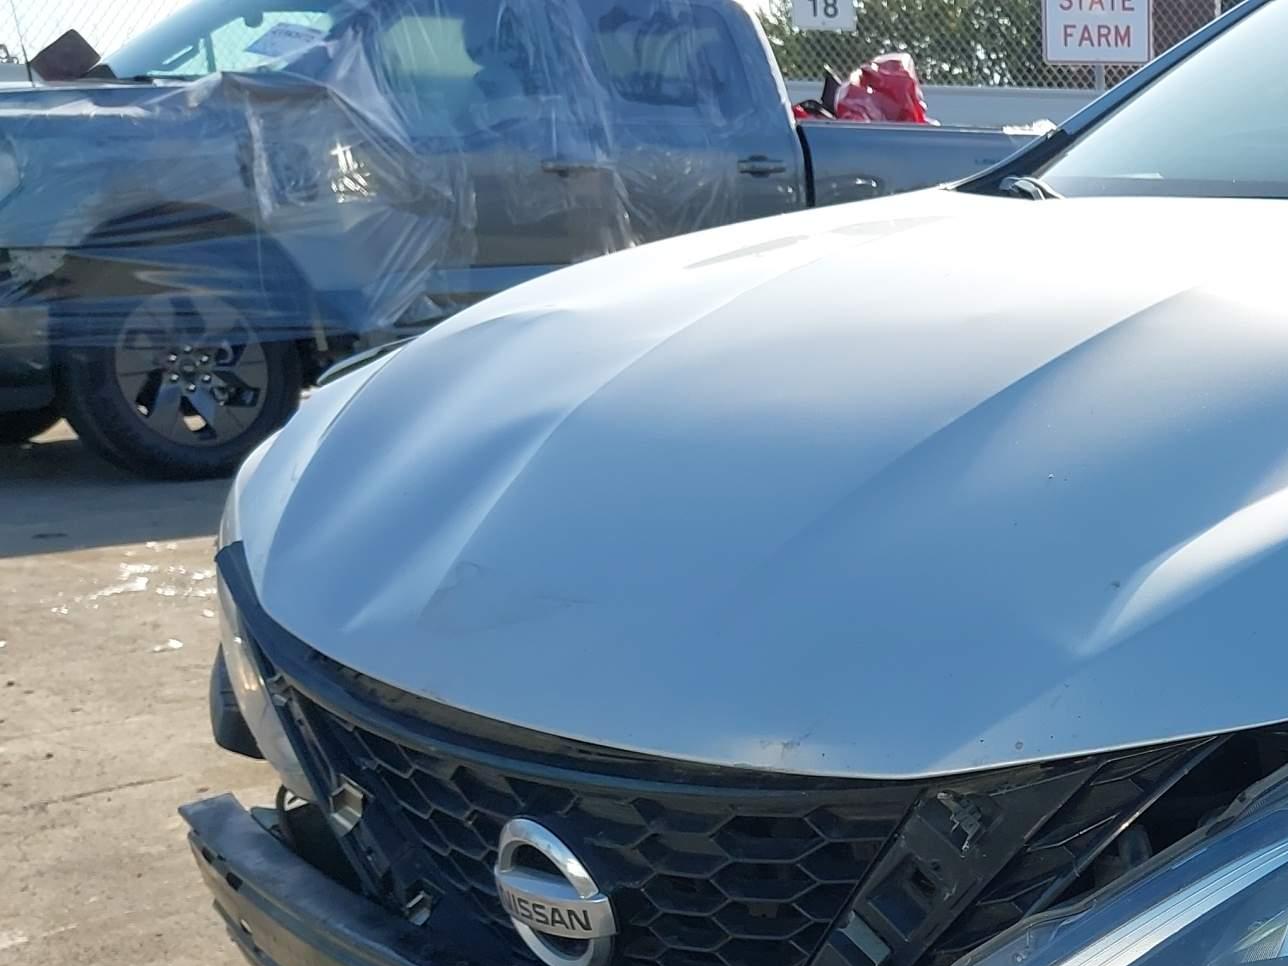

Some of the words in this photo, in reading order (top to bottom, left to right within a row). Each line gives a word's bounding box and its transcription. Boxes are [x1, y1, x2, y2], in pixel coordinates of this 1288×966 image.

[808, 0, 838, 18] 18
[1063, 24, 1131, 48] FARM
[499, 884, 593, 932] NISSAN
